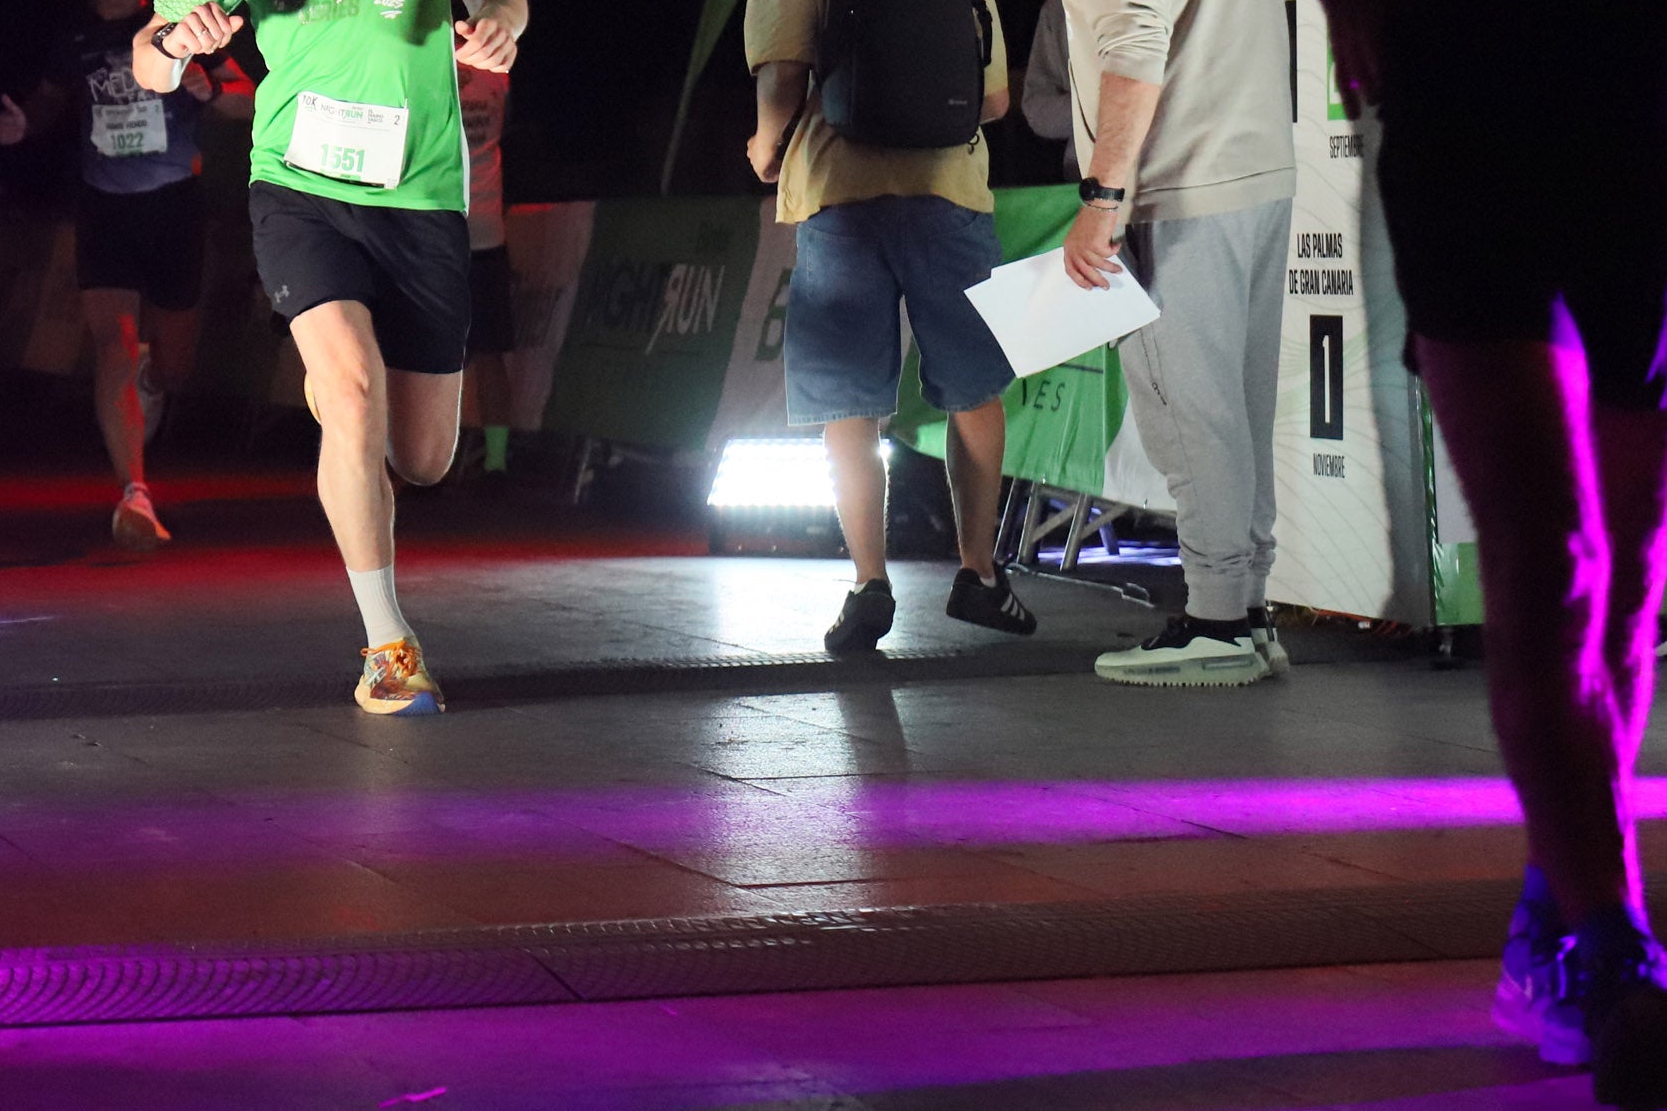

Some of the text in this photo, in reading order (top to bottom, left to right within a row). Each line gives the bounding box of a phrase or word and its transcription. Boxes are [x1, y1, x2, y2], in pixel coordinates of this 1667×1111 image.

[394, 114, 401, 126] 2
[110, 130, 144, 151] 1022
[1329, 134, 1365, 159] SEPTIEMBRE
[320, 142, 366, 173] 1551
[1297, 232, 1343, 259] LAS PALMAS
[1289, 268, 1354, 296] DE GRAN CANARIA
[1322, 334, 1331, 424] 1
[1313, 453, 1346, 479] NOVIEMBRE
